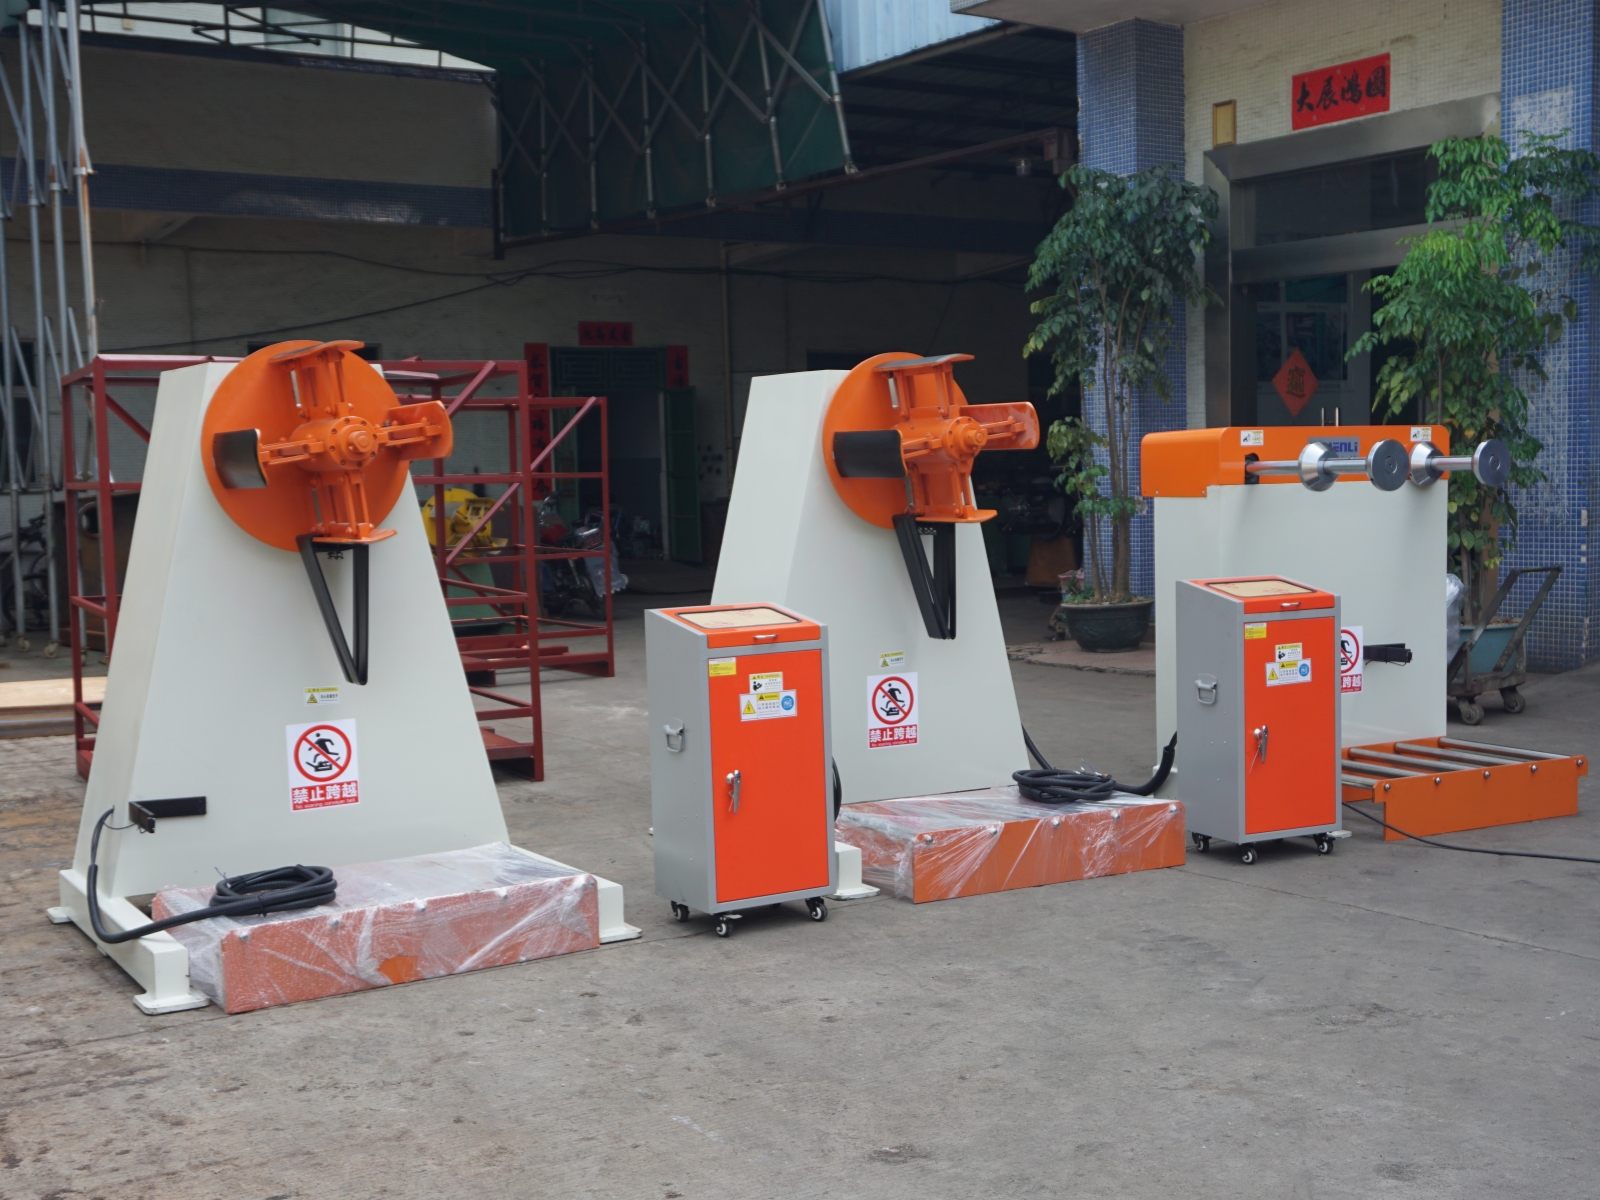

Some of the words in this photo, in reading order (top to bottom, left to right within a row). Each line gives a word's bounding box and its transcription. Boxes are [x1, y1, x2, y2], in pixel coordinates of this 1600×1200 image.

[869, 725, 917, 743] 禁止跨越
[293, 782, 358, 804] 禁止跨越
